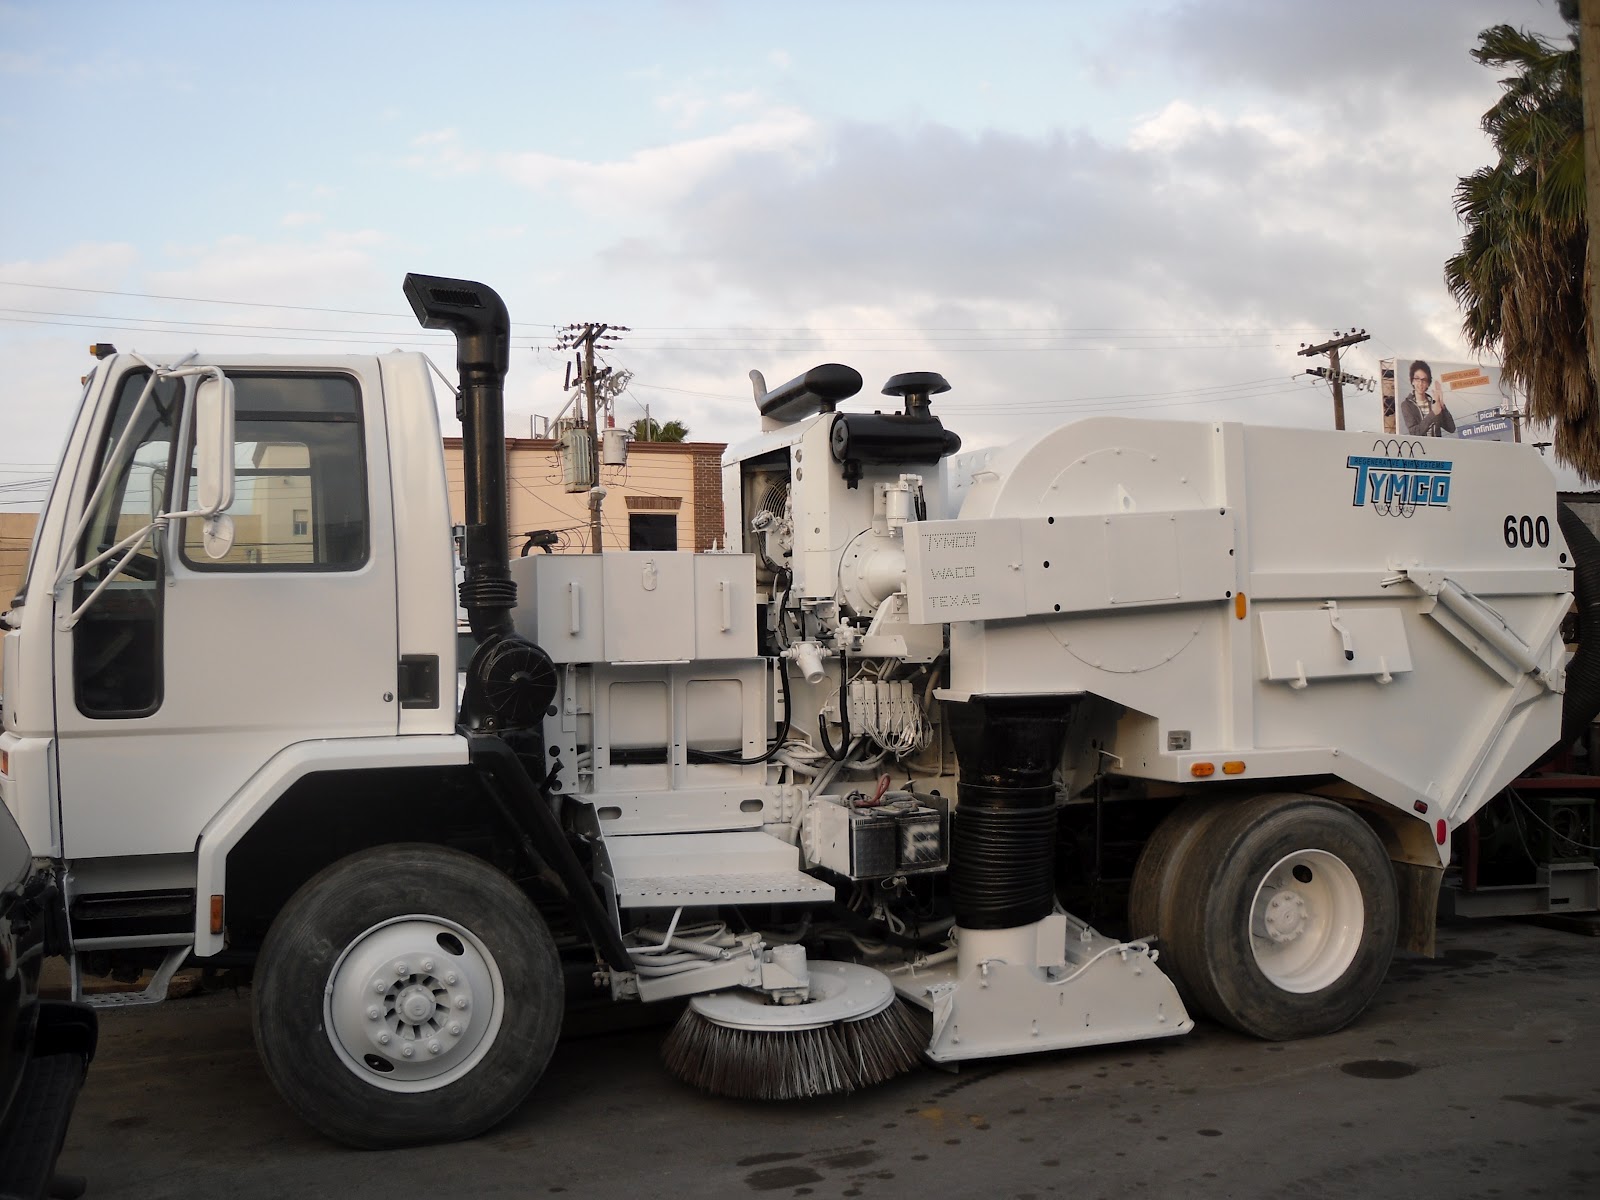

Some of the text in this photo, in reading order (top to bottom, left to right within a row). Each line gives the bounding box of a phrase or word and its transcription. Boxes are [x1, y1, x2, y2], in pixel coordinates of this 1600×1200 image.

[1355, 457, 1400, 466] REGENERATIVE
[1416, 461, 1445, 469] SYSTEMS
[1347, 455, 1453, 506] TYMCO
[1503, 514, 1550, 549] 600
[921, 531, 977, 552] TYMCO
[930, 566, 976, 580] WACO
[928, 593, 981, 608] TEXAS
